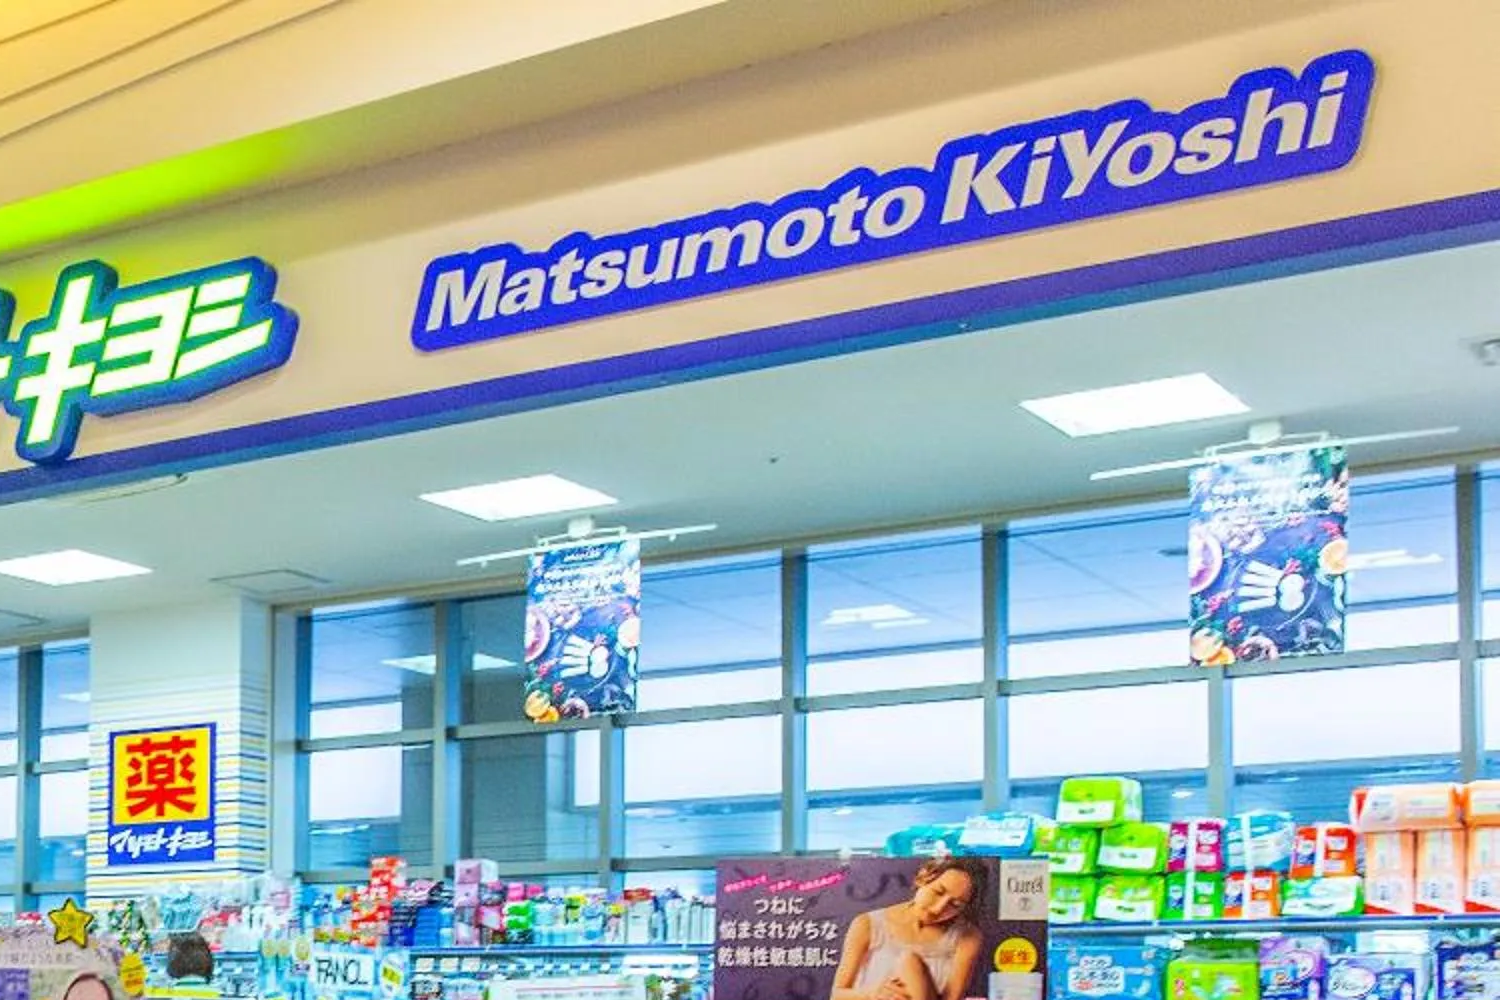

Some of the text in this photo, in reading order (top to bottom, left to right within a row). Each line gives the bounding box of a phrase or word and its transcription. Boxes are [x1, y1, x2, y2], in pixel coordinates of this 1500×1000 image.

[426, 72, 1349, 331] Matsumoto KiYoshi
[125, 735, 197, 817] 薬
[110, 826, 212, 859] マツモトキヨシ
[754, 896, 805, 915] つねに
[719, 920, 839, 941] 悩まされがちな
